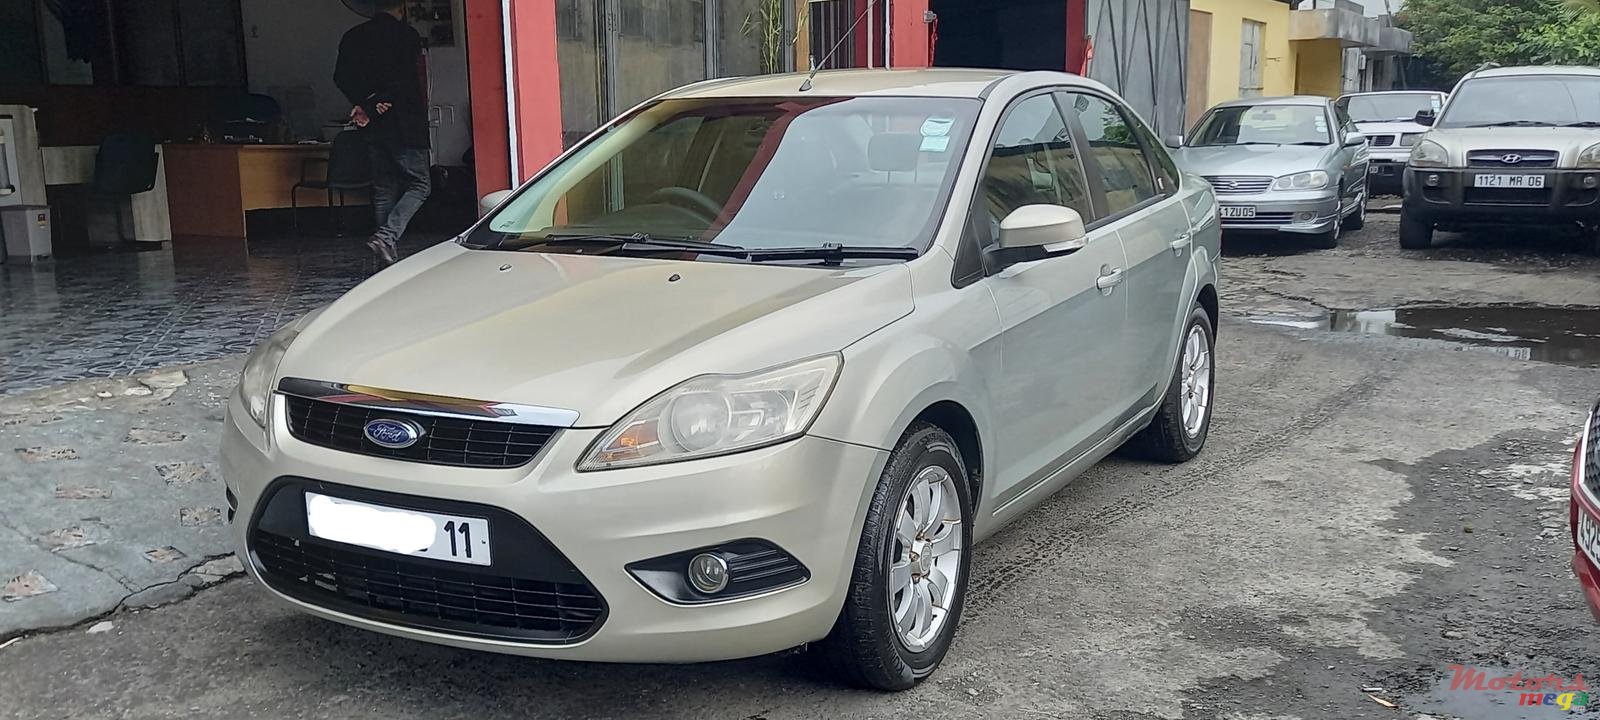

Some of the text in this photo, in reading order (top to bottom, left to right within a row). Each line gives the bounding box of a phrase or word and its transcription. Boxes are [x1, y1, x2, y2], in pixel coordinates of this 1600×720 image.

[1478, 175, 1542, 187] 1121 MR 06
[373, 423, 402, 442] Ford
[443, 520, 473, 559] 11
